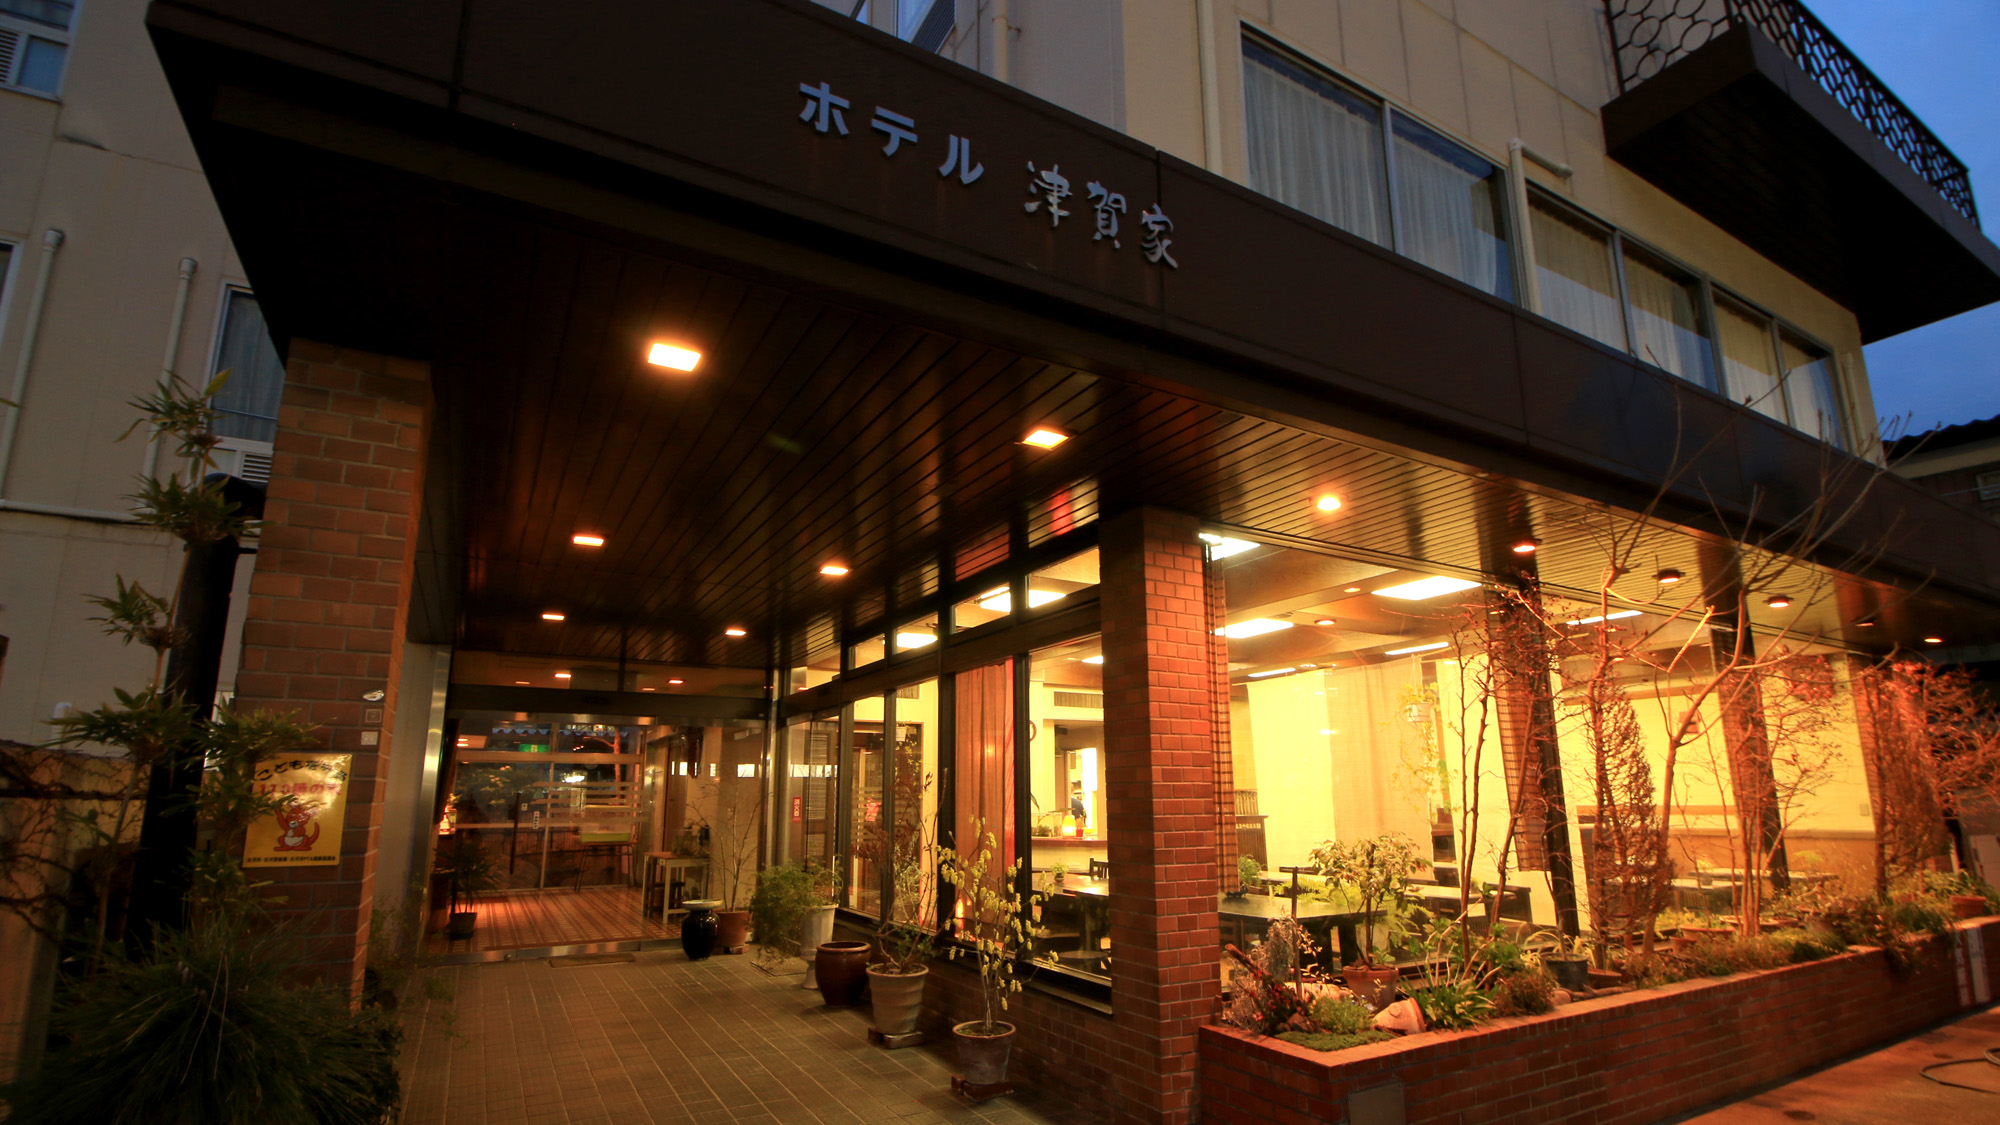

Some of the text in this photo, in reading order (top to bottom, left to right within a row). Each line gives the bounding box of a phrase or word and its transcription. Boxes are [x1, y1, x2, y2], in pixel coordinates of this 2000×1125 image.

[799, 81, 1179, 269] ホテル 津賀家
